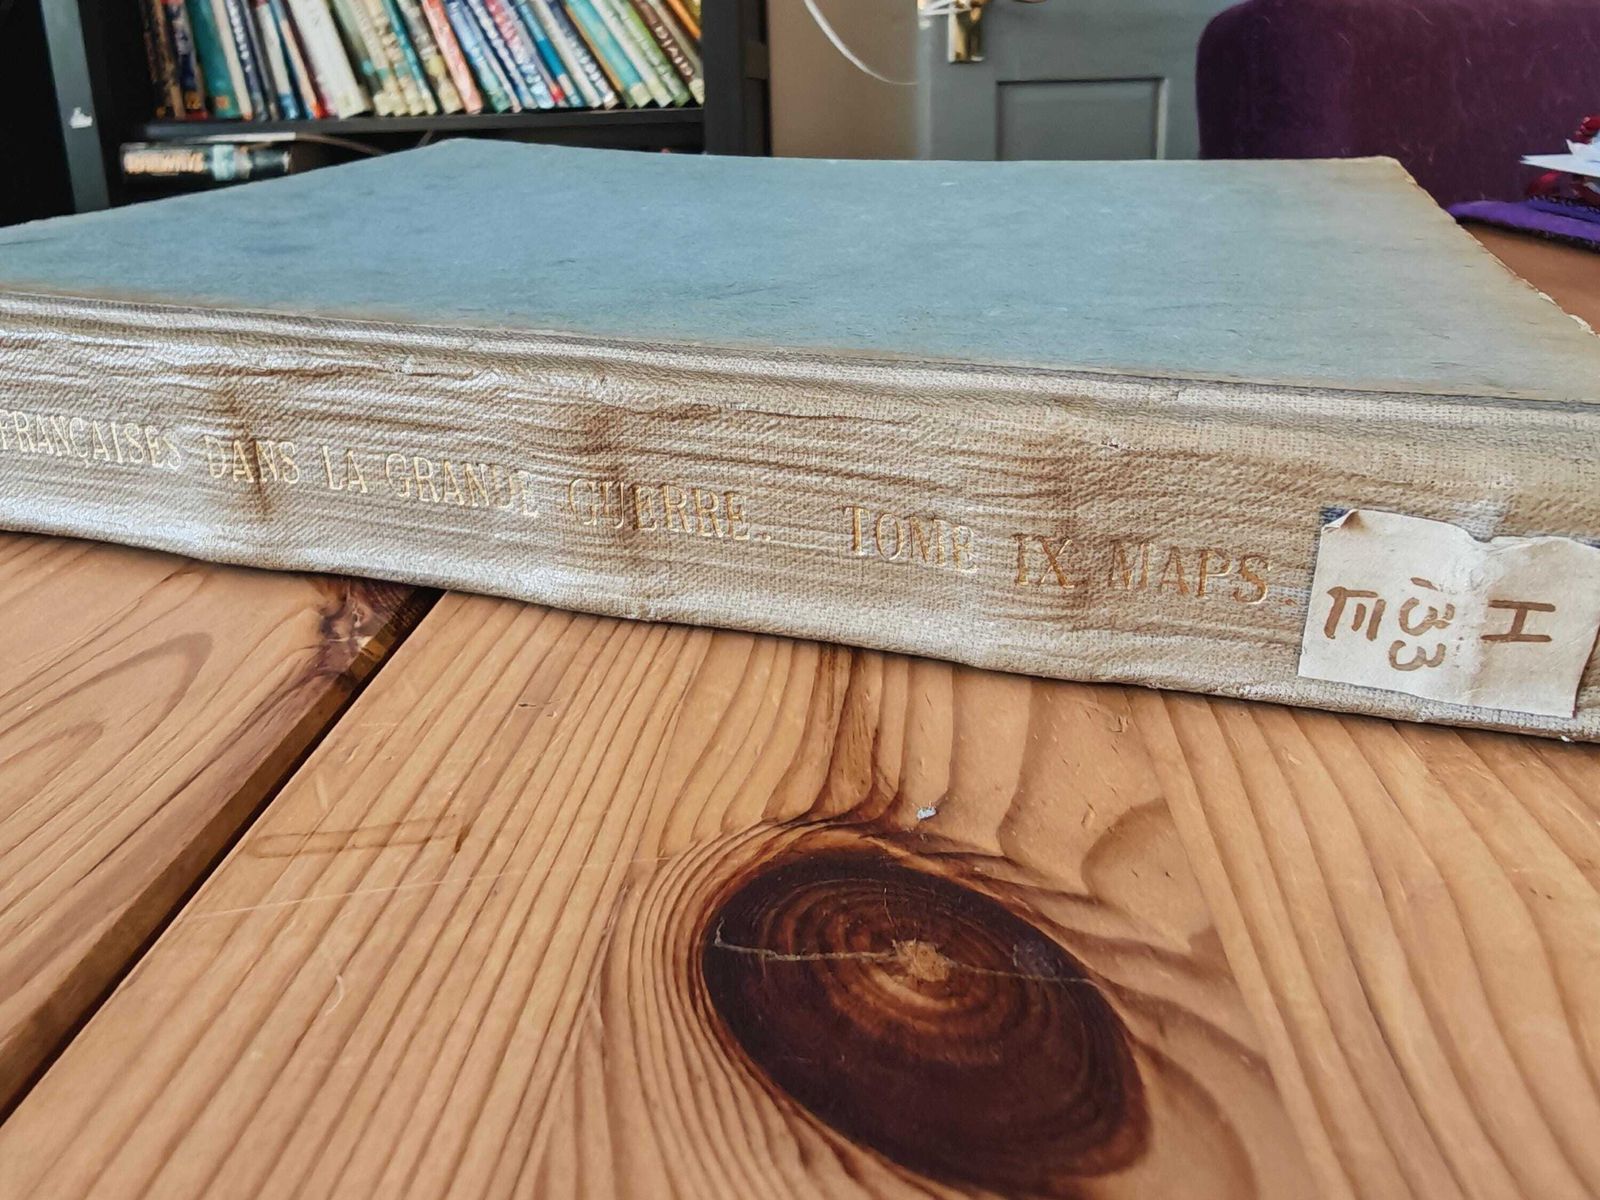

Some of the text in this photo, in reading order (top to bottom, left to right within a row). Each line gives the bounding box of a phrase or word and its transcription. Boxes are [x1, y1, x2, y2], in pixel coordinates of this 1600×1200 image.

[204, 429, 301, 487] DANS
[322, 443, 369, 494] LA
[384, 452, 541, 520] GRANDE
[842, 505, 979, 575] TOME
[1014, 532, 1077, 589] IX
[1480, 598, 1557, 643] H
